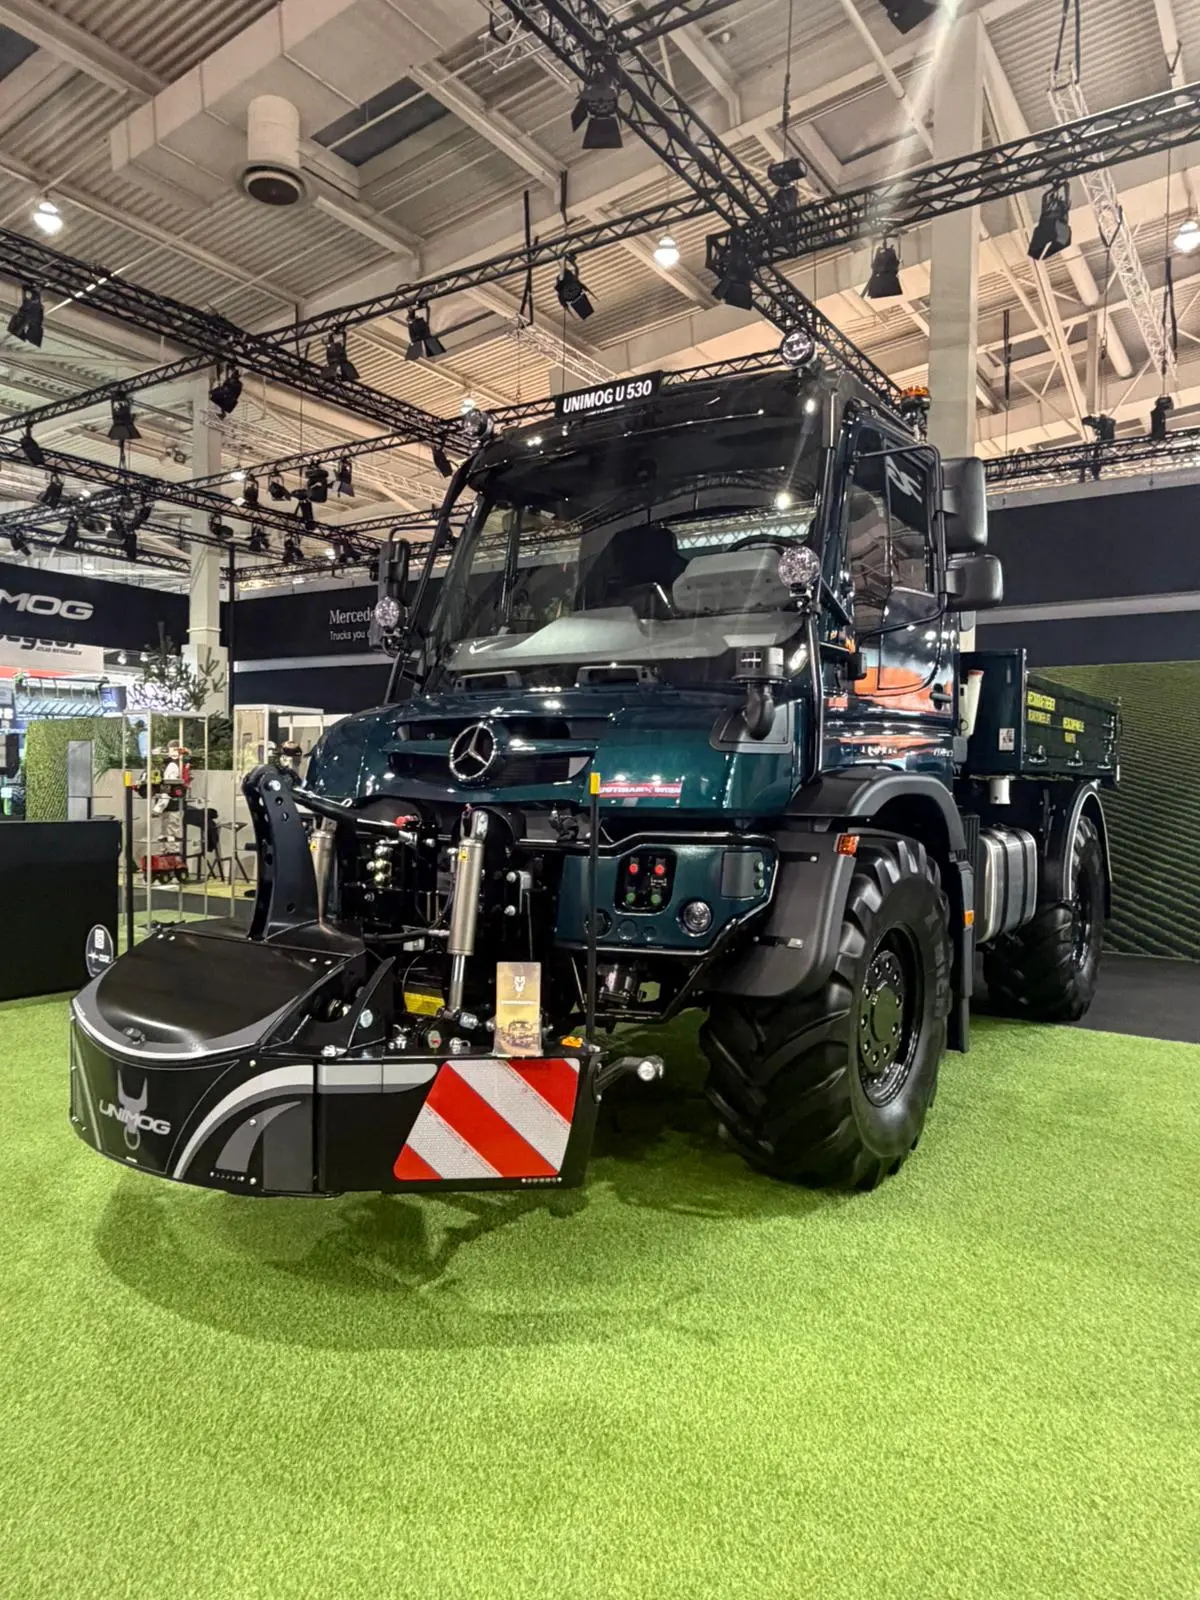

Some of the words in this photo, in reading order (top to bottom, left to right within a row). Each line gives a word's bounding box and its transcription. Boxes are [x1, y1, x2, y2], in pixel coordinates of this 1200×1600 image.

[563, 388, 613, 413] UNIMOG
[615, 385, 625, 402] U
[626, 379, 652, 399] 530
[330, 631, 351, 641] Trucks
[353, 631, 365, 642] you
[99, 1099, 172, 1135] UNIMOG
